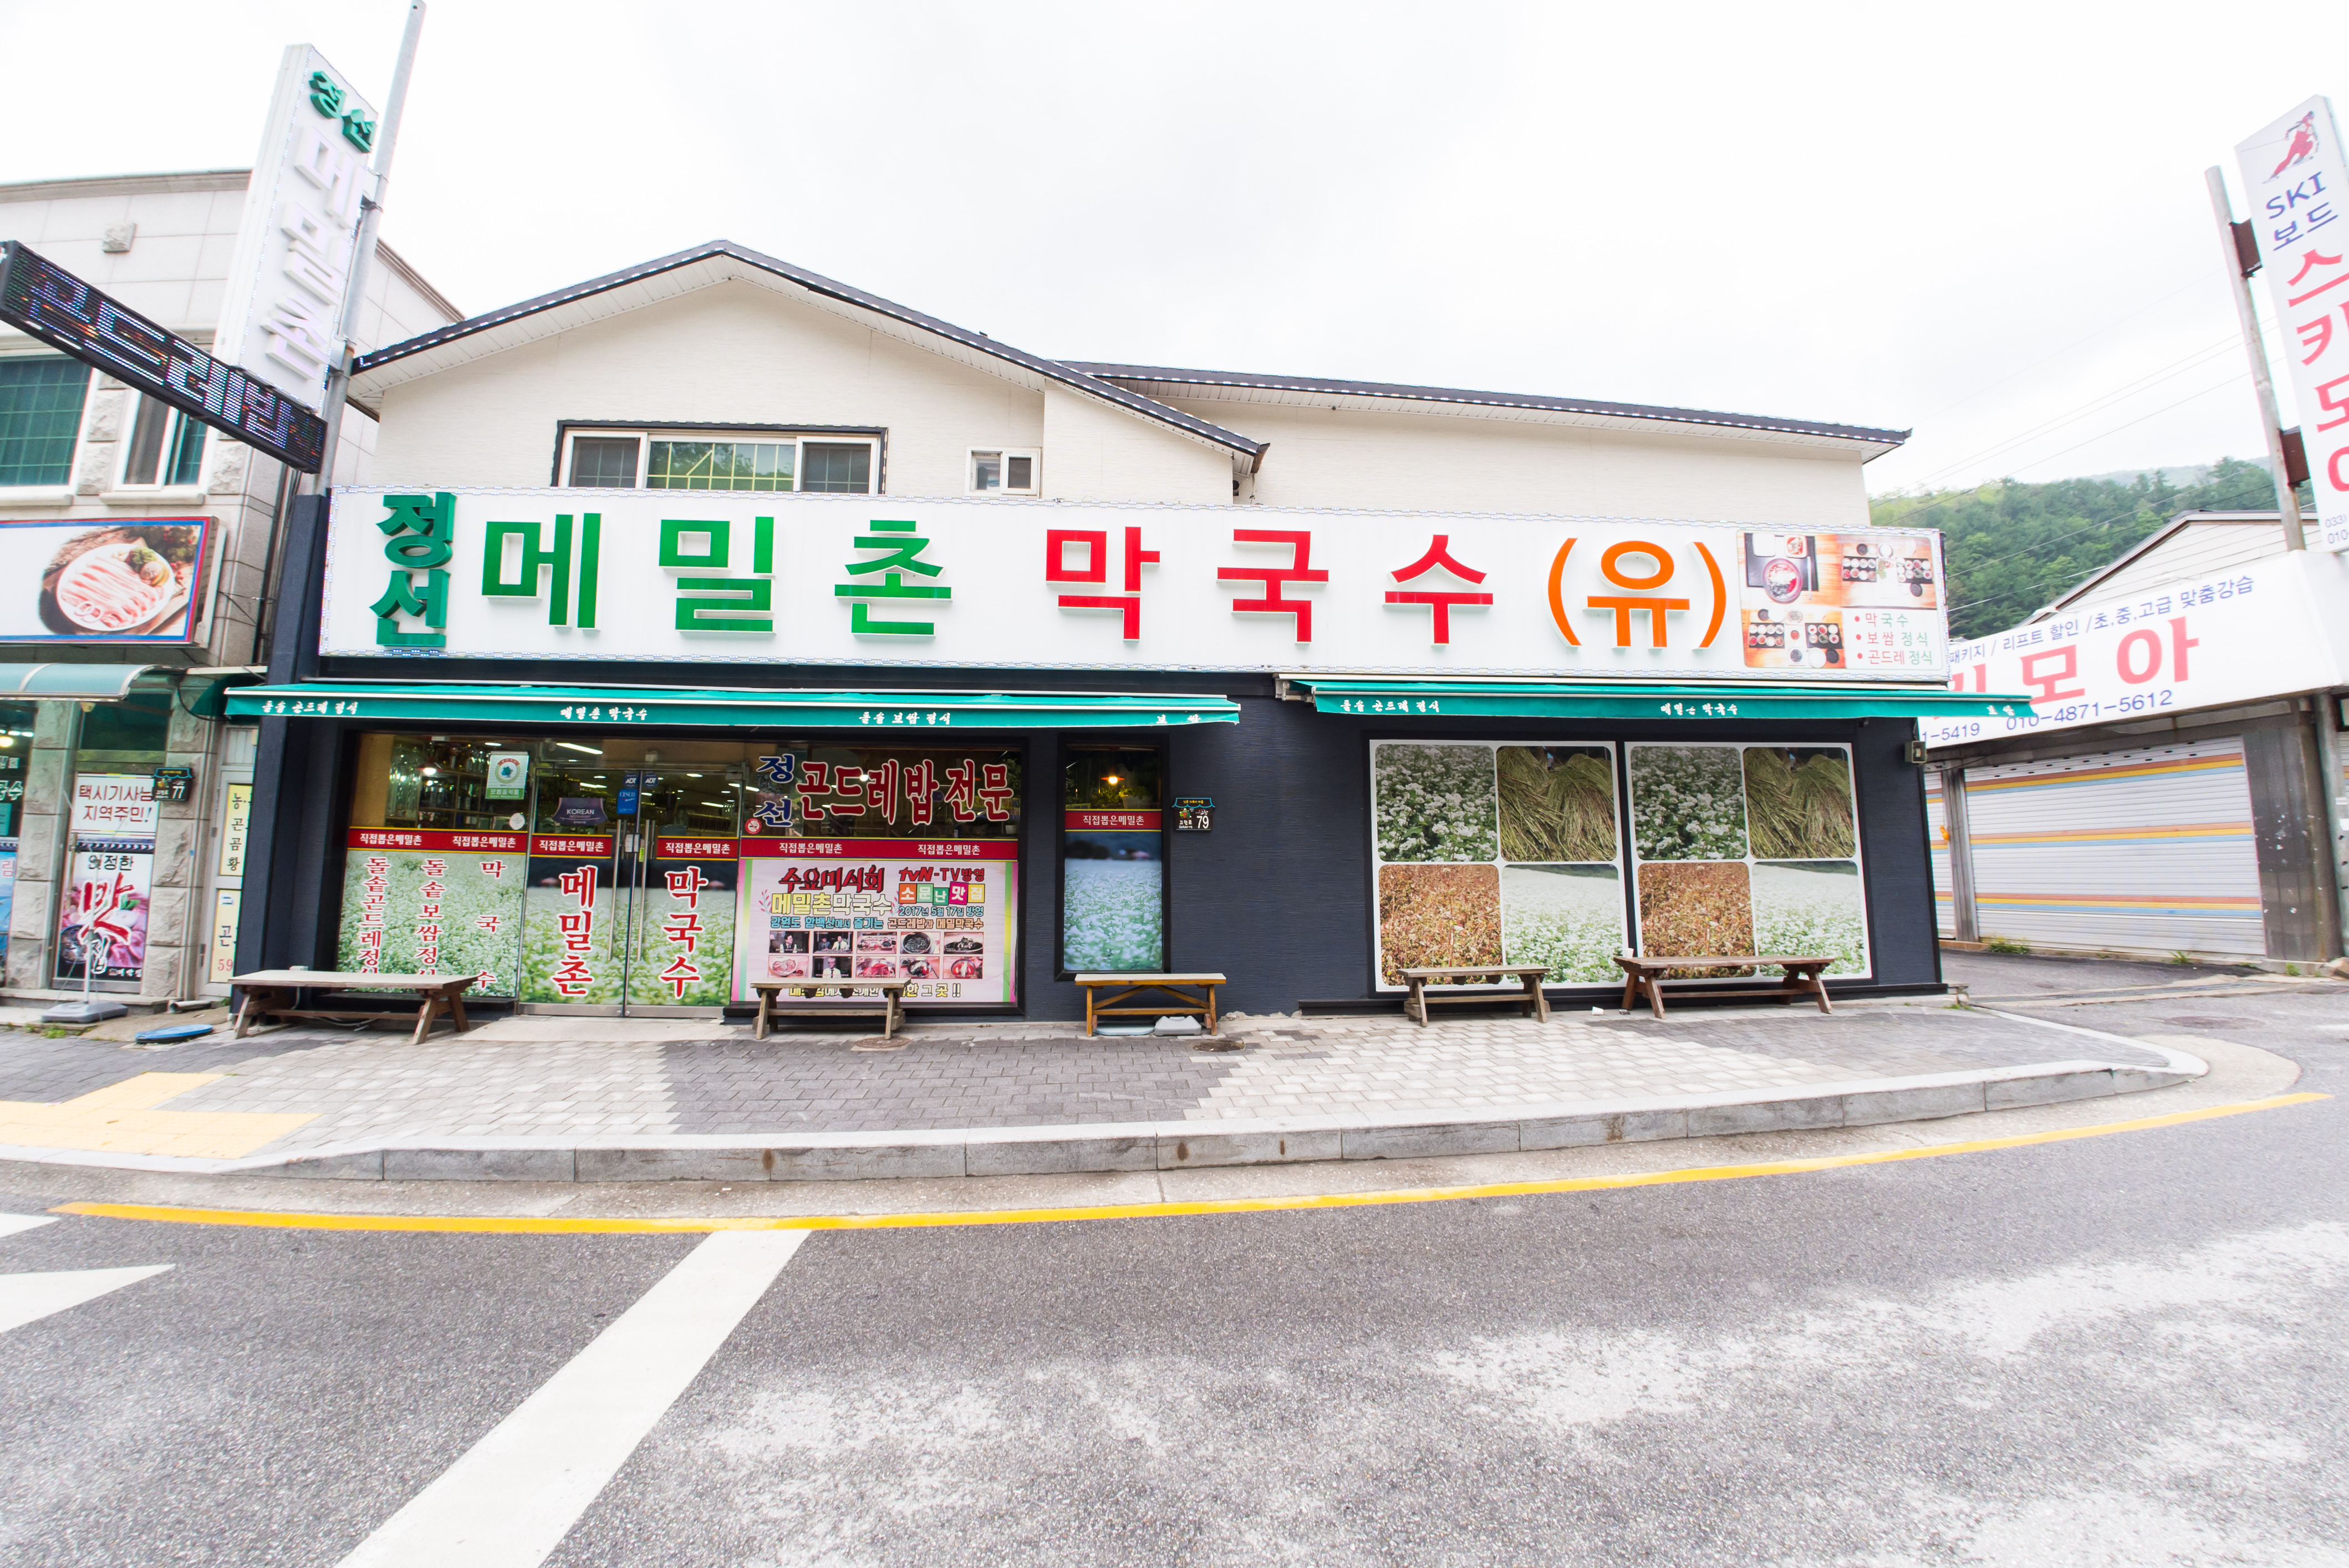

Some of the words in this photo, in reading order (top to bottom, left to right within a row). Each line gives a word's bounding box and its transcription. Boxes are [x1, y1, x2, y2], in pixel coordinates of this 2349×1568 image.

[308, 70, 376, 154] 정선
[2266, 171, 2327, 220] SKI
[2273, 201, 2339, 251] 보드
[259, 126, 366, 380] 메밀촌
[369, 492, 457, 648] 정선
[481, 512, 952, 638] 메밀촌
[1865, 613, 1909, 628] 막국수
[1949, 643, 1985, 664] 패키지
[2003, 629, 2044, 650] 리프트
[2050, 619, 2079, 641] 할인
[2180, 575, 2254, 609] 맞춤강습
[1867, 632, 1894, 646] 보쌈
[1901, 632, 1928, 647] 정식
[1868, 650, 1905, 665] 곤드레
[1909, 650, 1933, 665] 정식
[560, 706, 600, 720] 메밀촌
[609, 706, 648, 721] 막국수
[891, 712, 920, 725] 보쌈
[926, 712, 951, 725] 정식
[1702, 702, 1738, 716] 막국수
[2006, 689, 2173, 731] 010-4871-5612
[172, 786, 185, 799] 77
[754, 753, 794, 827] 정선
[83, 805, 152, 823] 지역주민!
[1196, 815, 1209, 829] 79
[778, 864, 886, 893] 수요미식회
[771, 892, 893, 916] 메밀촌막국수
[898, 906, 929, 917] 2017년
[930, 907, 944, 917] 5월
[946, 907, 964, 917] 17일
[966, 906, 984, 917] 방영
[551, 866, 598, 996] 메밀촌
[660, 866, 709, 998] 막국수
[771, 916, 801, 929] 강원도
[804, 916, 851, 929] 함백산에서
[853, 917, 884, 929] 즐기는
[888, 918, 934, 930] 곤드레밥과
[936, 918, 984, 930] 메밀막국수
